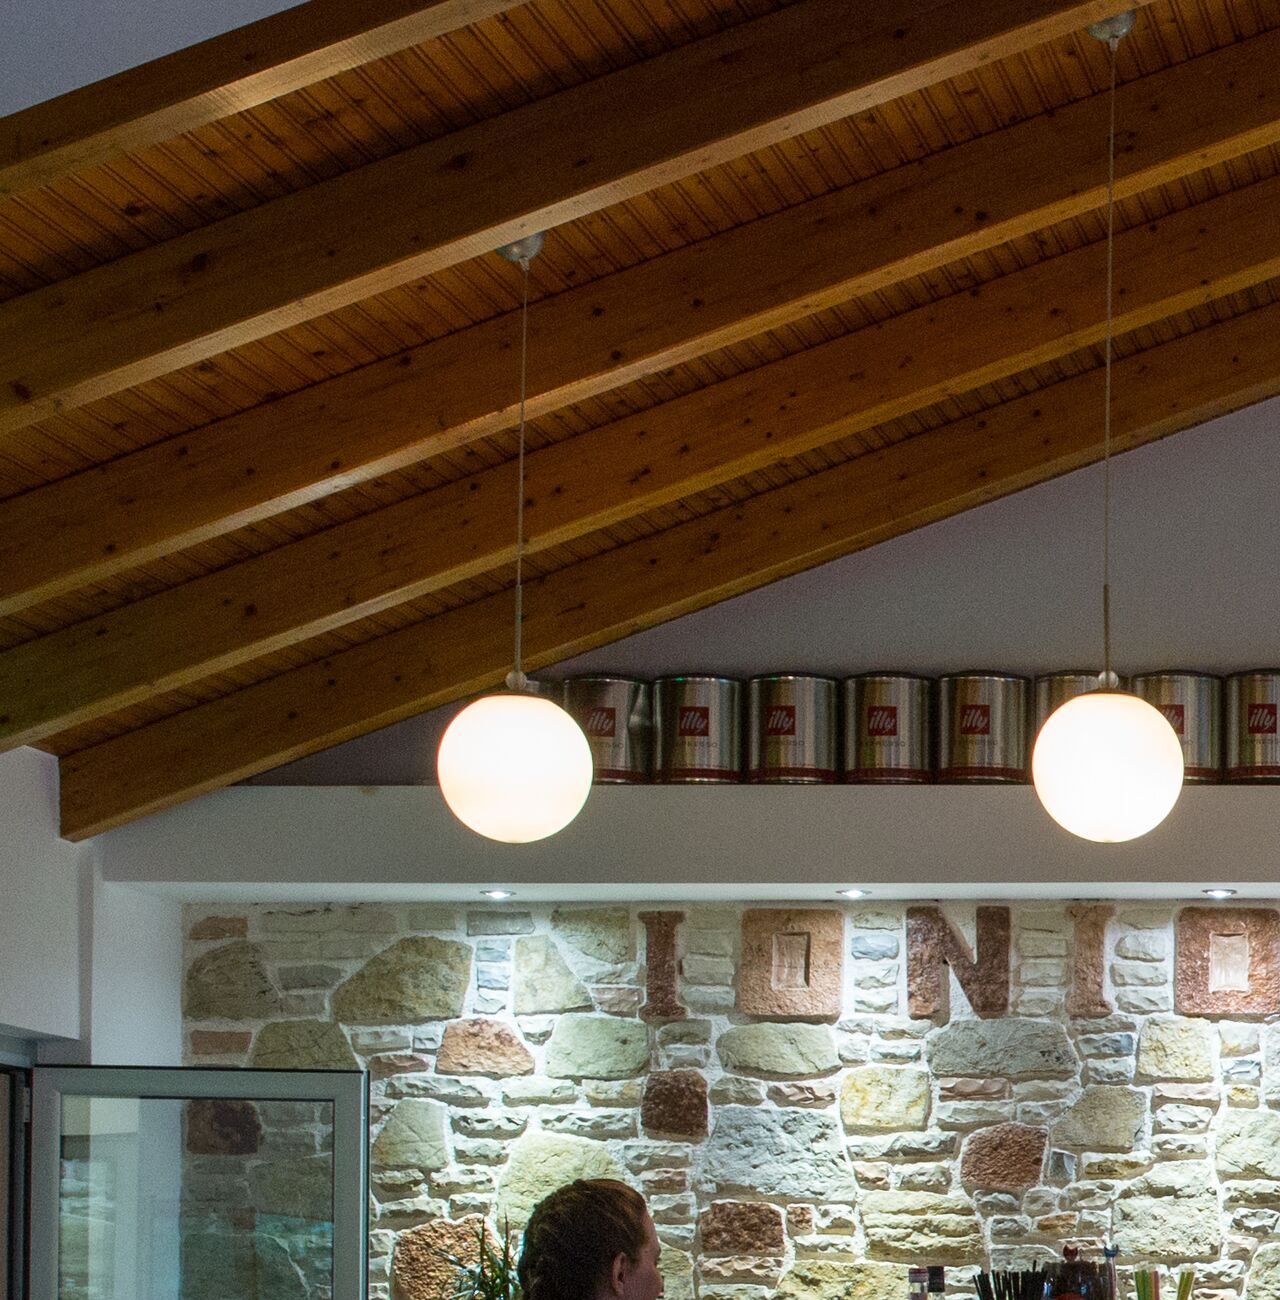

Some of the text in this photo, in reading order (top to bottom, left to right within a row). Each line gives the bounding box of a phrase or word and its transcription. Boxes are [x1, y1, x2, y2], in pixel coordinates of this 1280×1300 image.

[587, 710, 613, 732] illy
[681, 711, 707, 733] illy
[768, 709, 794, 732] illy
[869, 710, 896, 733] illy
[961, 708, 988, 731] illy
[1249, 708, 1275, 730] illy
